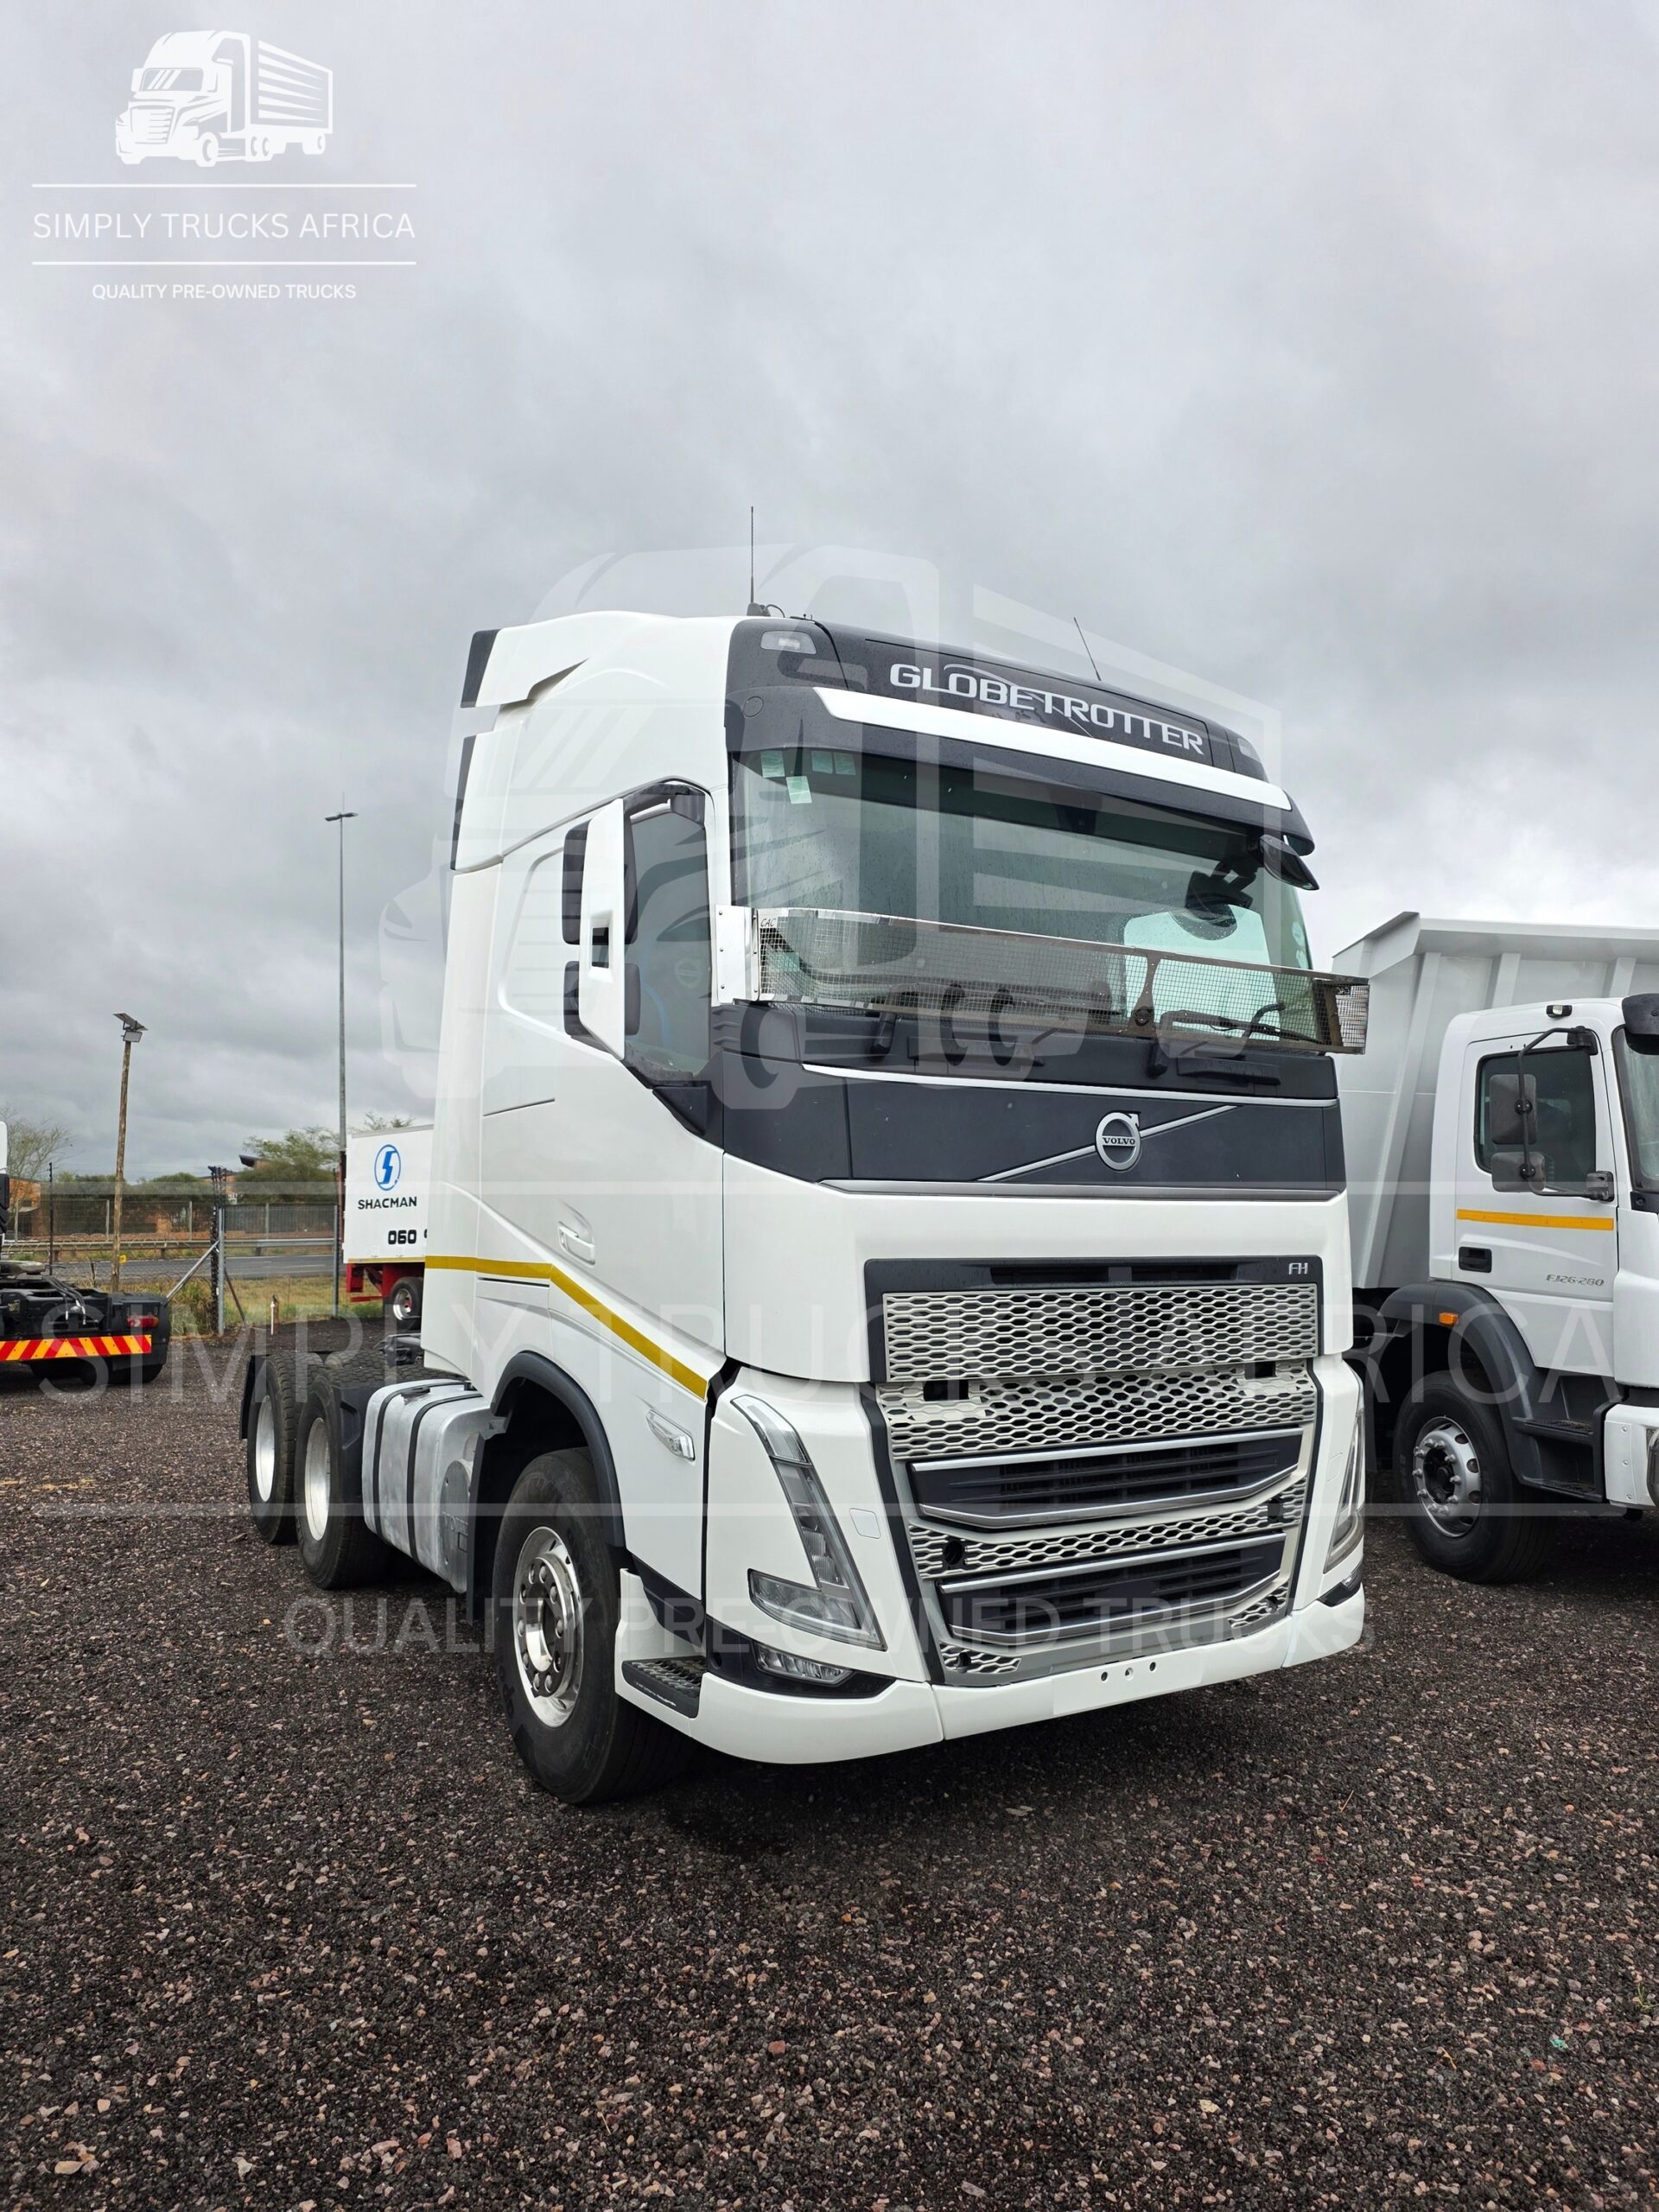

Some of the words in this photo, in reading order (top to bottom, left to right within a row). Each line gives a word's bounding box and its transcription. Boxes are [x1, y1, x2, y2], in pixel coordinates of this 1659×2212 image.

[889, 663, 1205, 755] GLOBETROTTER
[1102, 1136, 1136, 1146] VOLVO
[358, 1196, 417, 1210] SHACMAN
[388, 1229, 417, 1245] 060
[1288, 1262, 1308, 1275] FH
